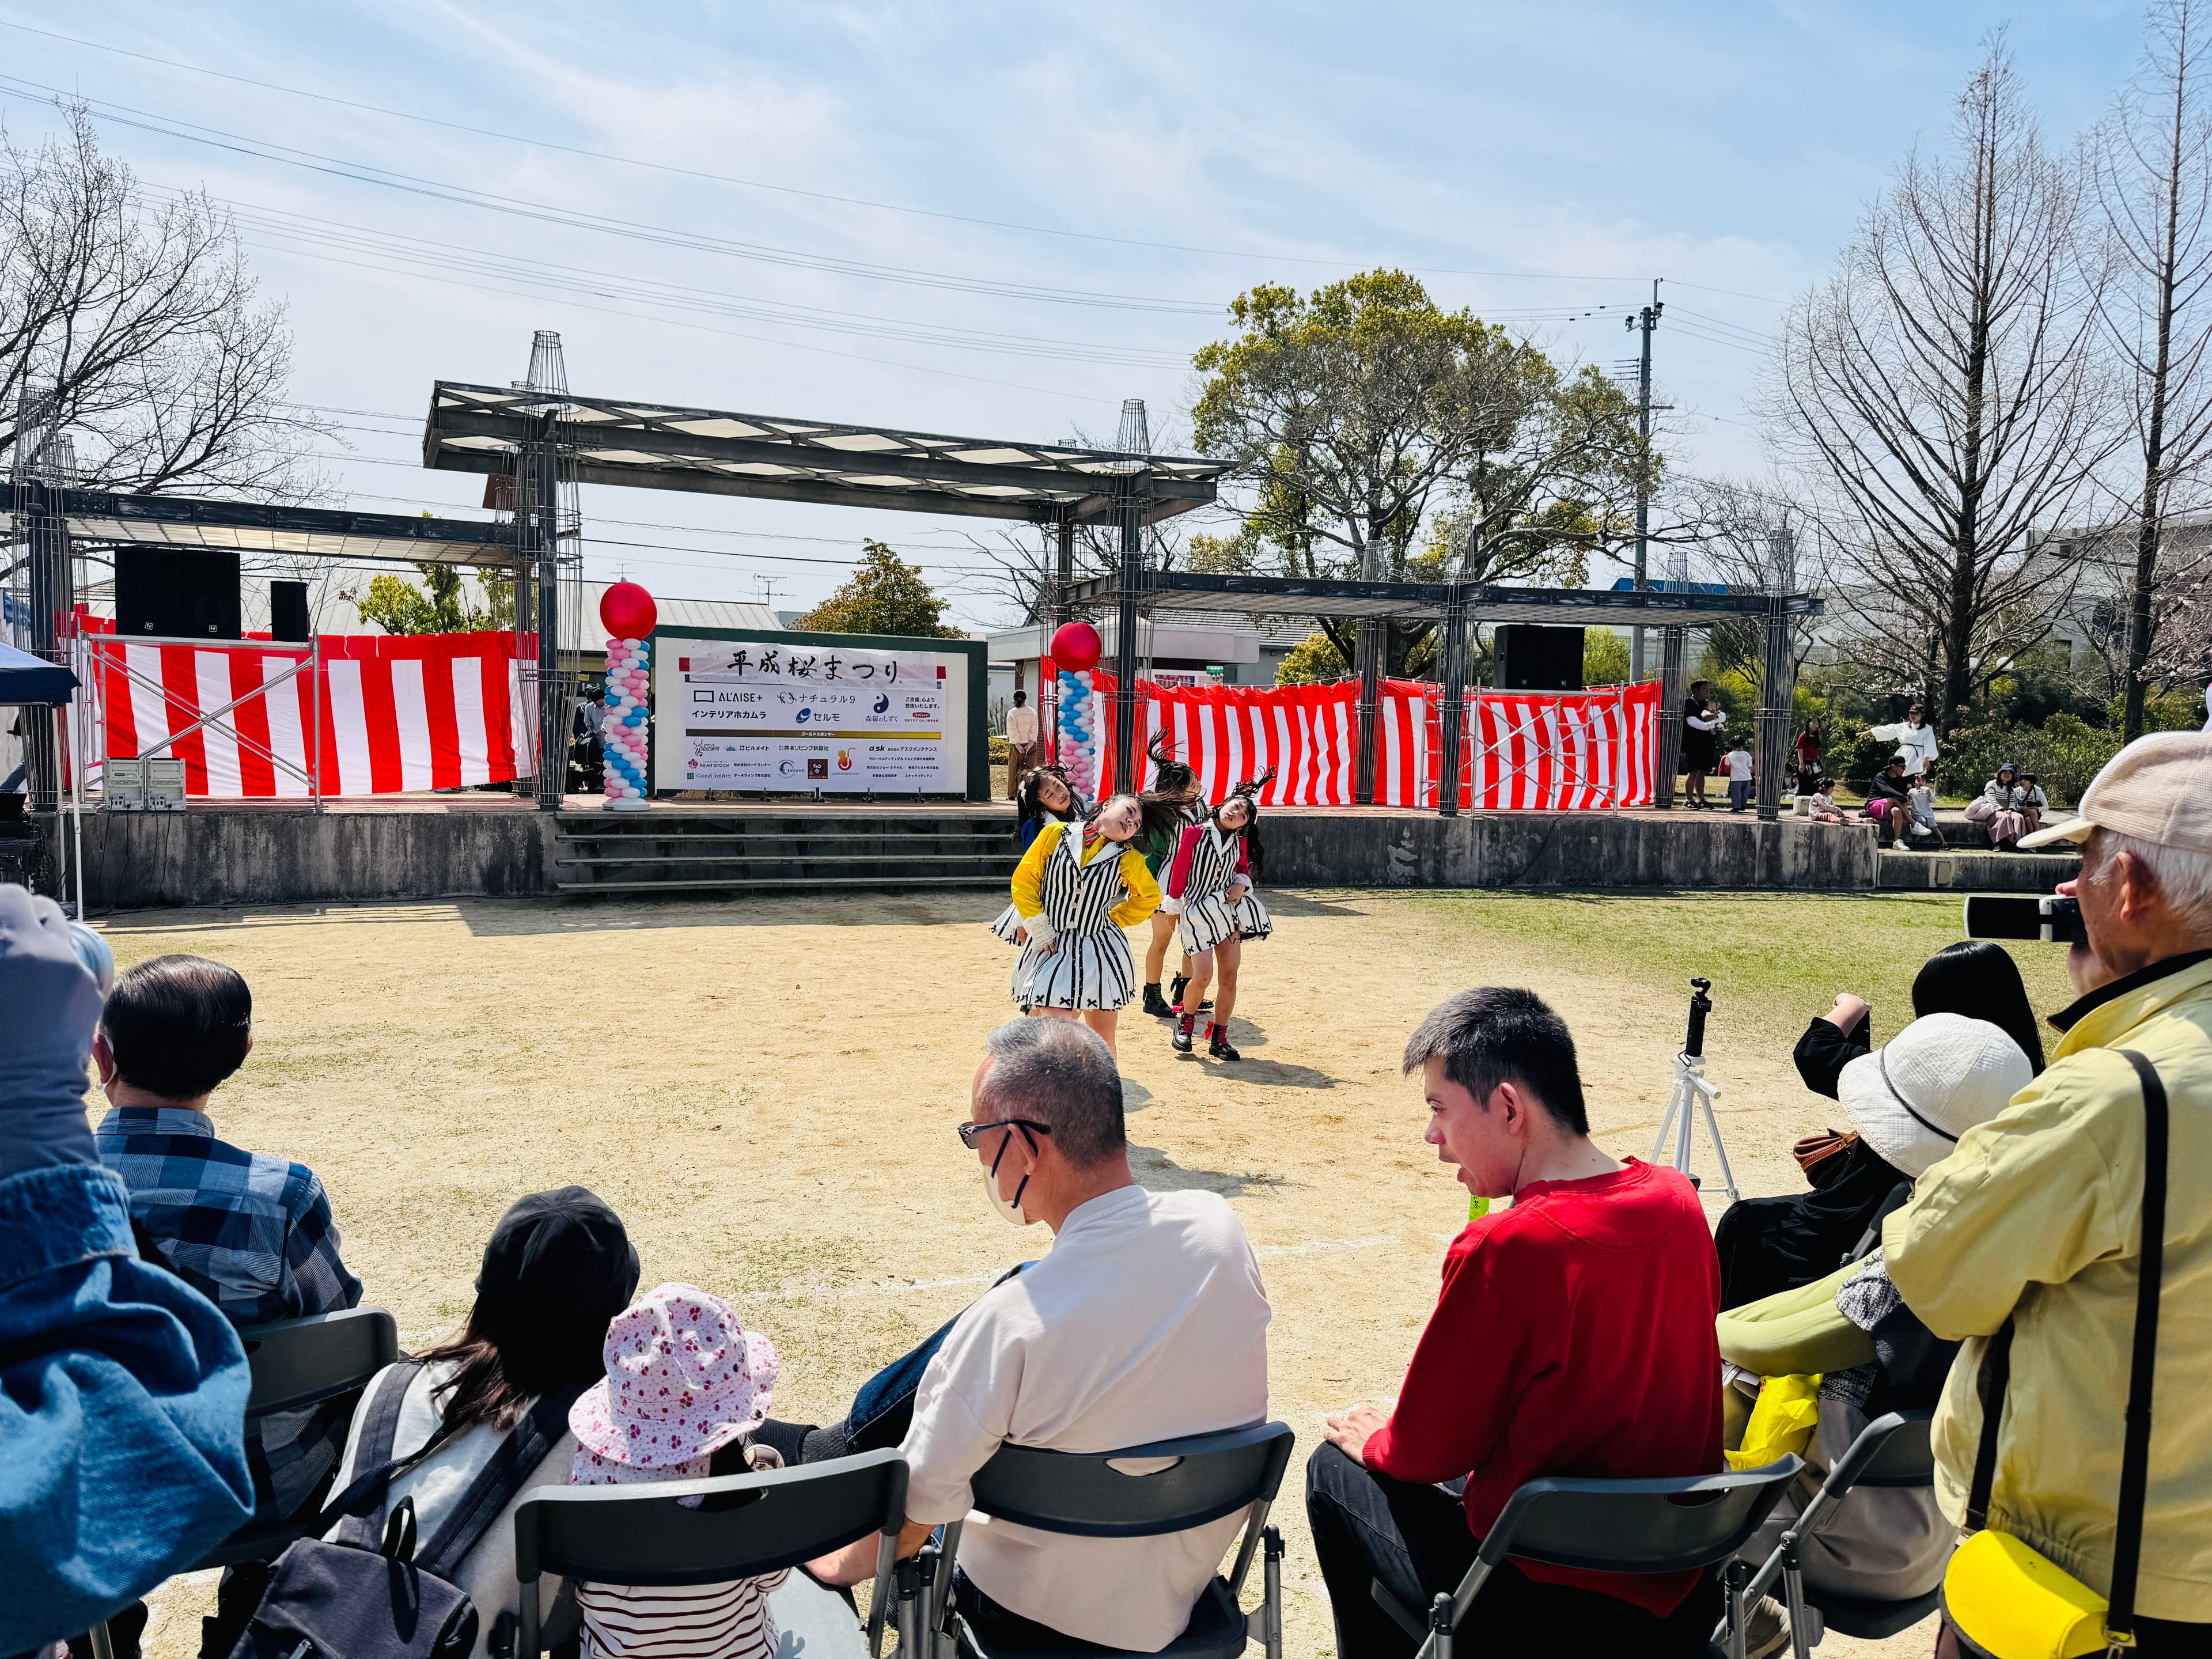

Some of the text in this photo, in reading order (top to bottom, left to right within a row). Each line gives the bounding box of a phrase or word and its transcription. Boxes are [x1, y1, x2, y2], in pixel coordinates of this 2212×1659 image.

[727, 650, 897, 684] 平成桜まつり
[692, 710, 766, 719] インテリアホカムラ
[813, 713, 840, 722] セルモ
